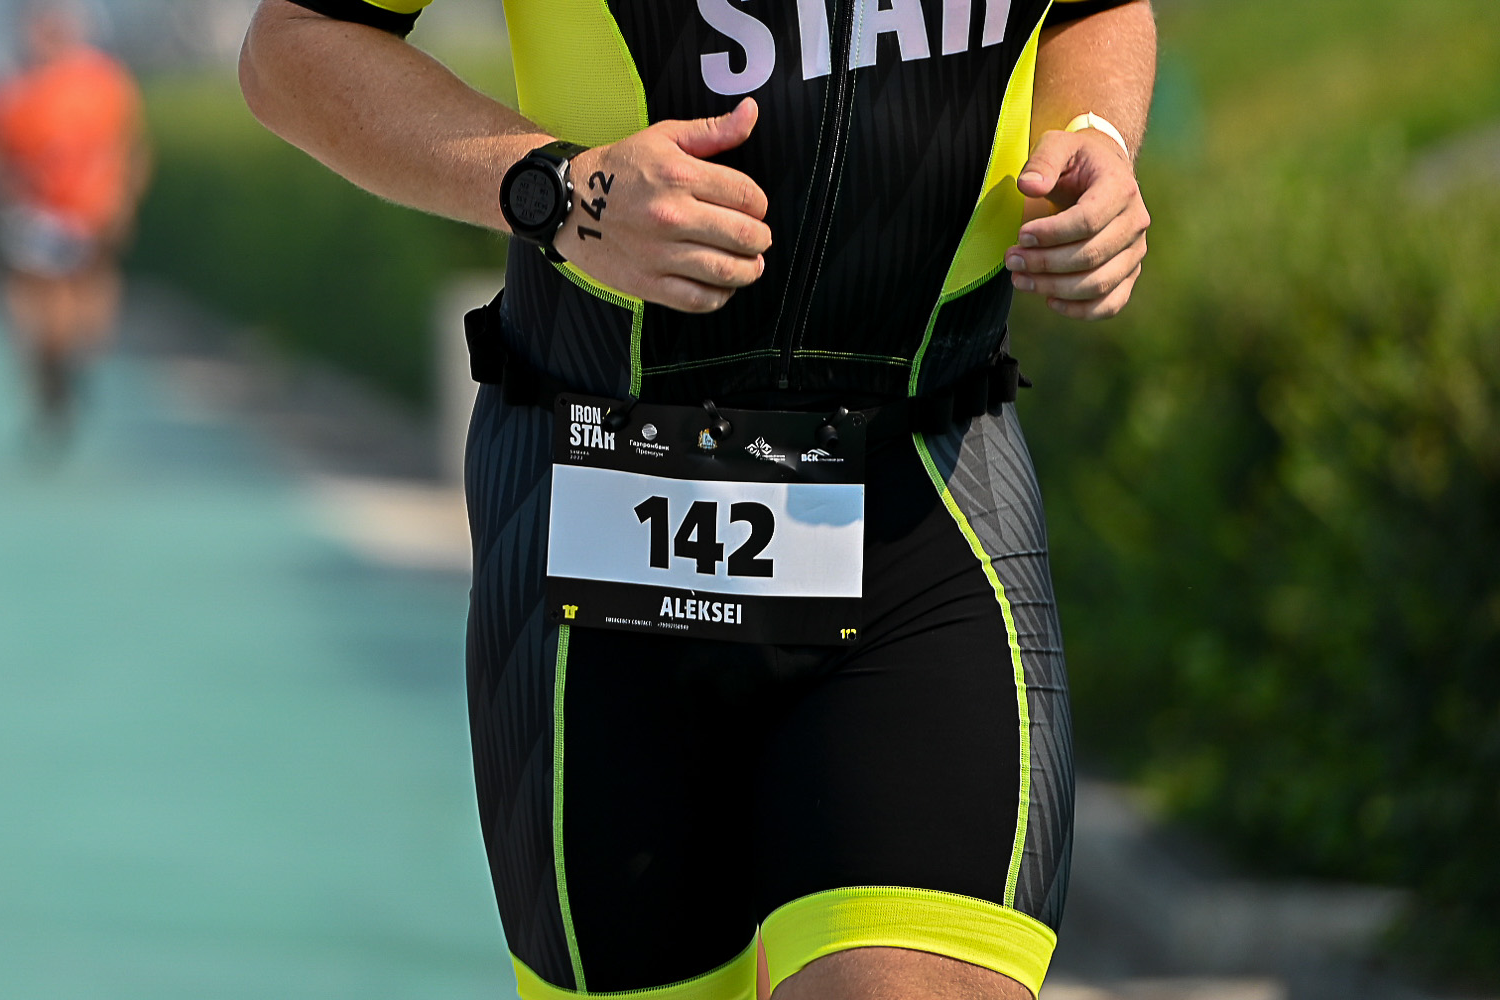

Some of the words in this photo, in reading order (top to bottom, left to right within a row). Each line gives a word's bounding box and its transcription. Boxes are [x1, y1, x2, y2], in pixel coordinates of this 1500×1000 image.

[577, 170, 615, 241] 142
[570, 403, 602, 425] IRON
[569, 422, 616, 451] STAR
[633, 495, 776, 578] 142
[659, 596, 743, 625] ALEKSEI
